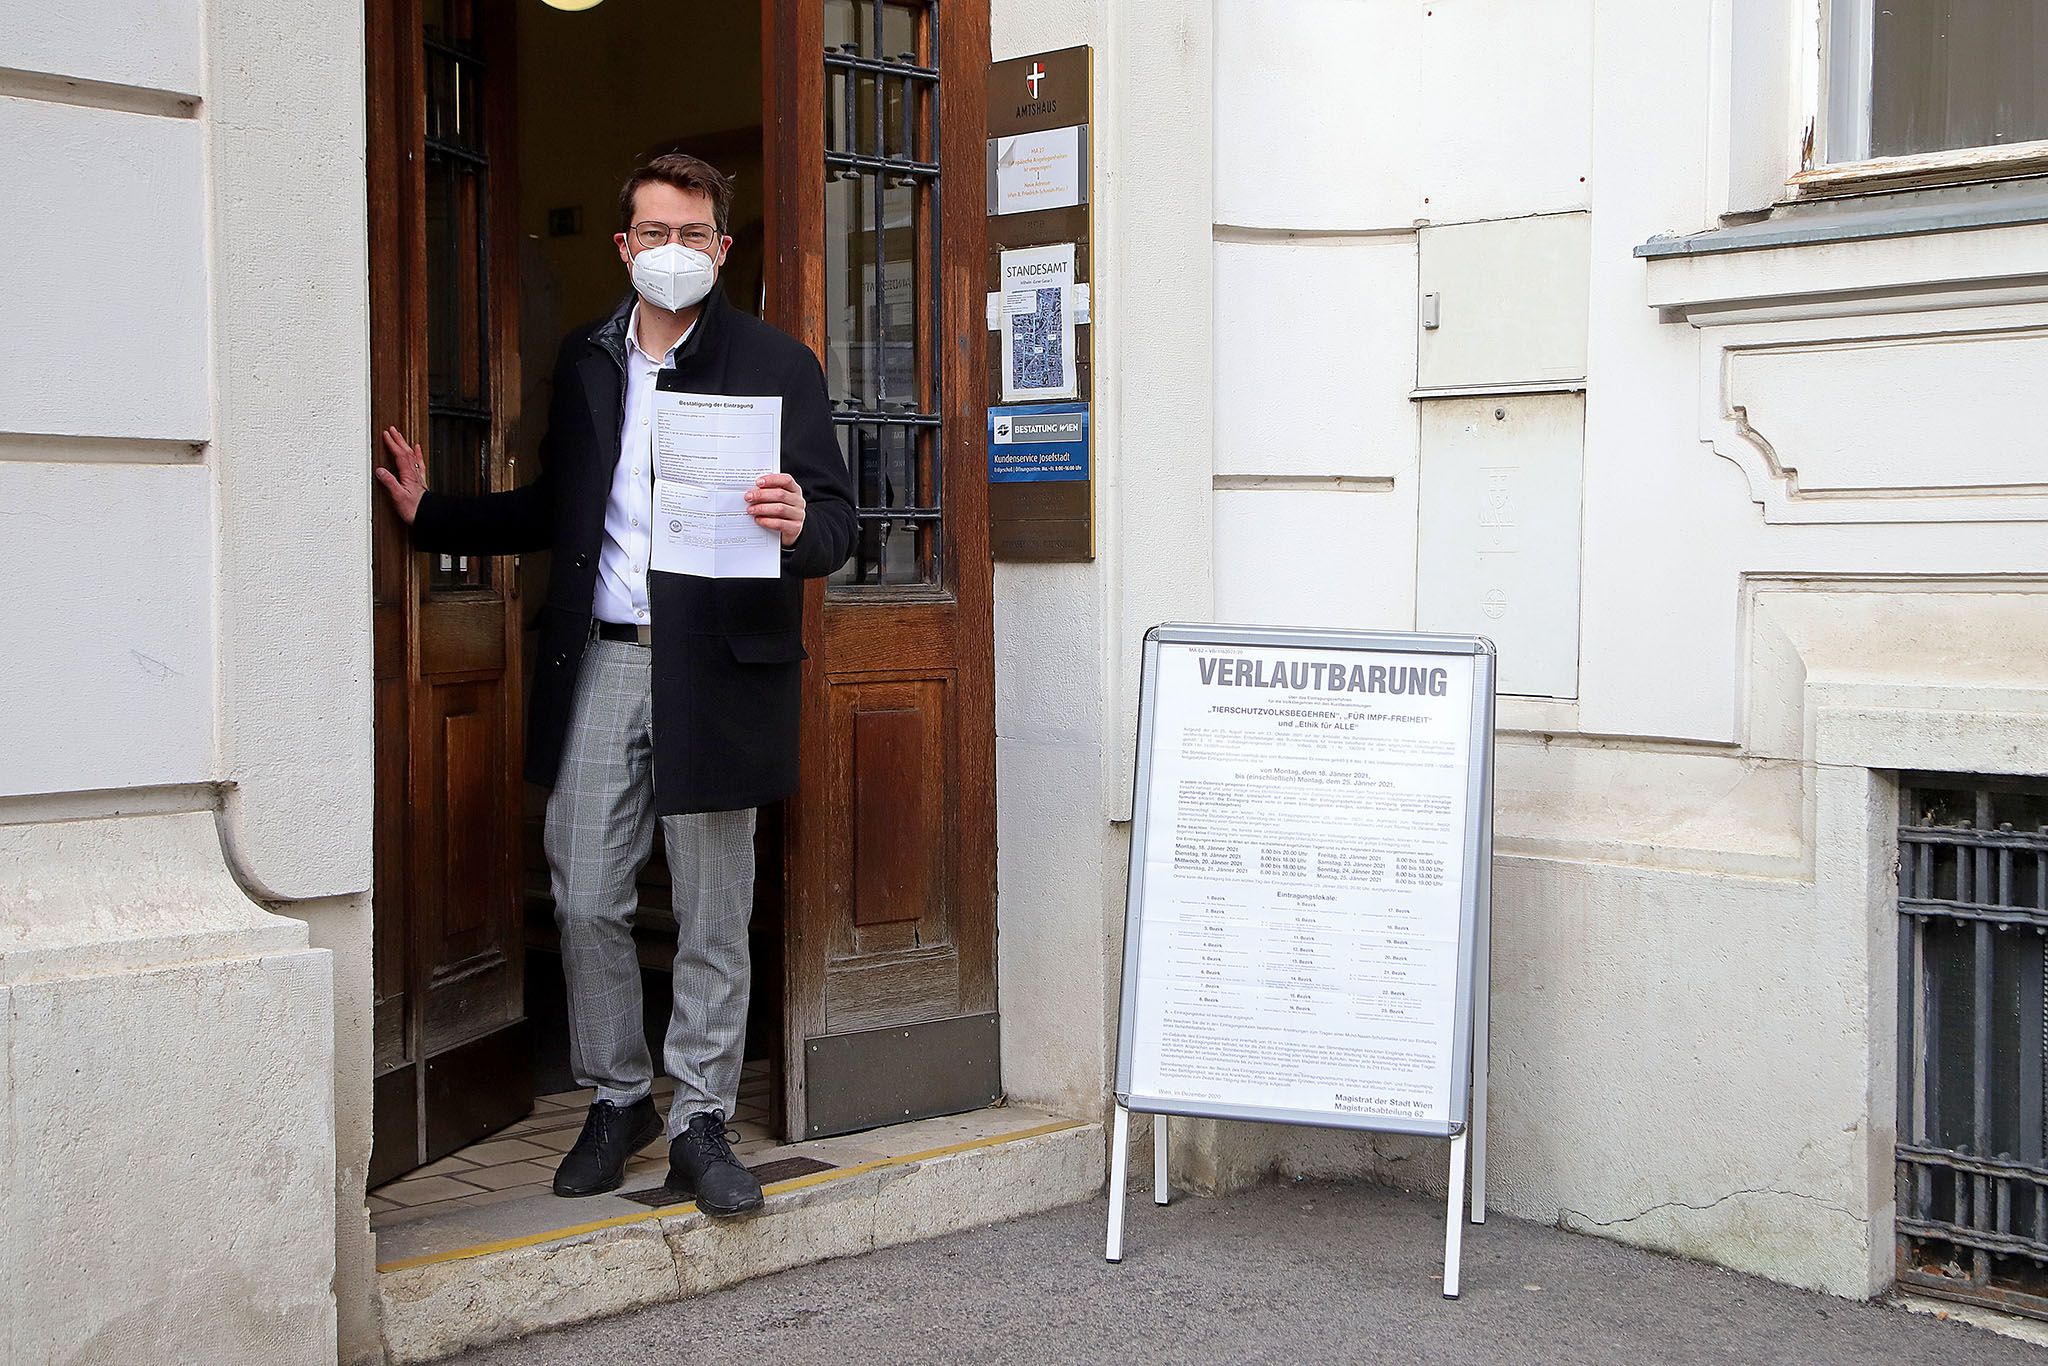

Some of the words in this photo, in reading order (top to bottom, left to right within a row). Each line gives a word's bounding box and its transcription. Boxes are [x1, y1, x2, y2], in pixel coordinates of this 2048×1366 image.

[1016, 101, 1056, 118] AMTSHAUS
[1007, 262, 1067, 278] STANDESAMT
[1015, 424, 1057, 433] BESTATTUNG
[994, 453, 1038, 463] Kundenservice
[1039, 452, 1070, 464] Josefstadt
[1199, 658, 1448, 696] VERLAUTBARUNG
[1366, 713, 1431, 723] IMPF-FREIHEIT“
[1246, 773, 1296, 782] (einschließlich)
[1273, 767, 1300, 777] Montag,
[1301, 769, 1316, 778] dem
[1328, 771, 1351, 780] Jänner
[1228, 853, 1241, 861] 2021
[1368, 855, 1382, 863] 2021
[1276, 891, 1337, 902] Eintragungslokale:
[1334, 1093, 1372, 1104] Magistrat
[1389, 1098, 1410, 1107] Stadt
[1334, 1101, 1412, 1118] Magistratsabteilung
[1414, 1110, 1424, 1119] 62
